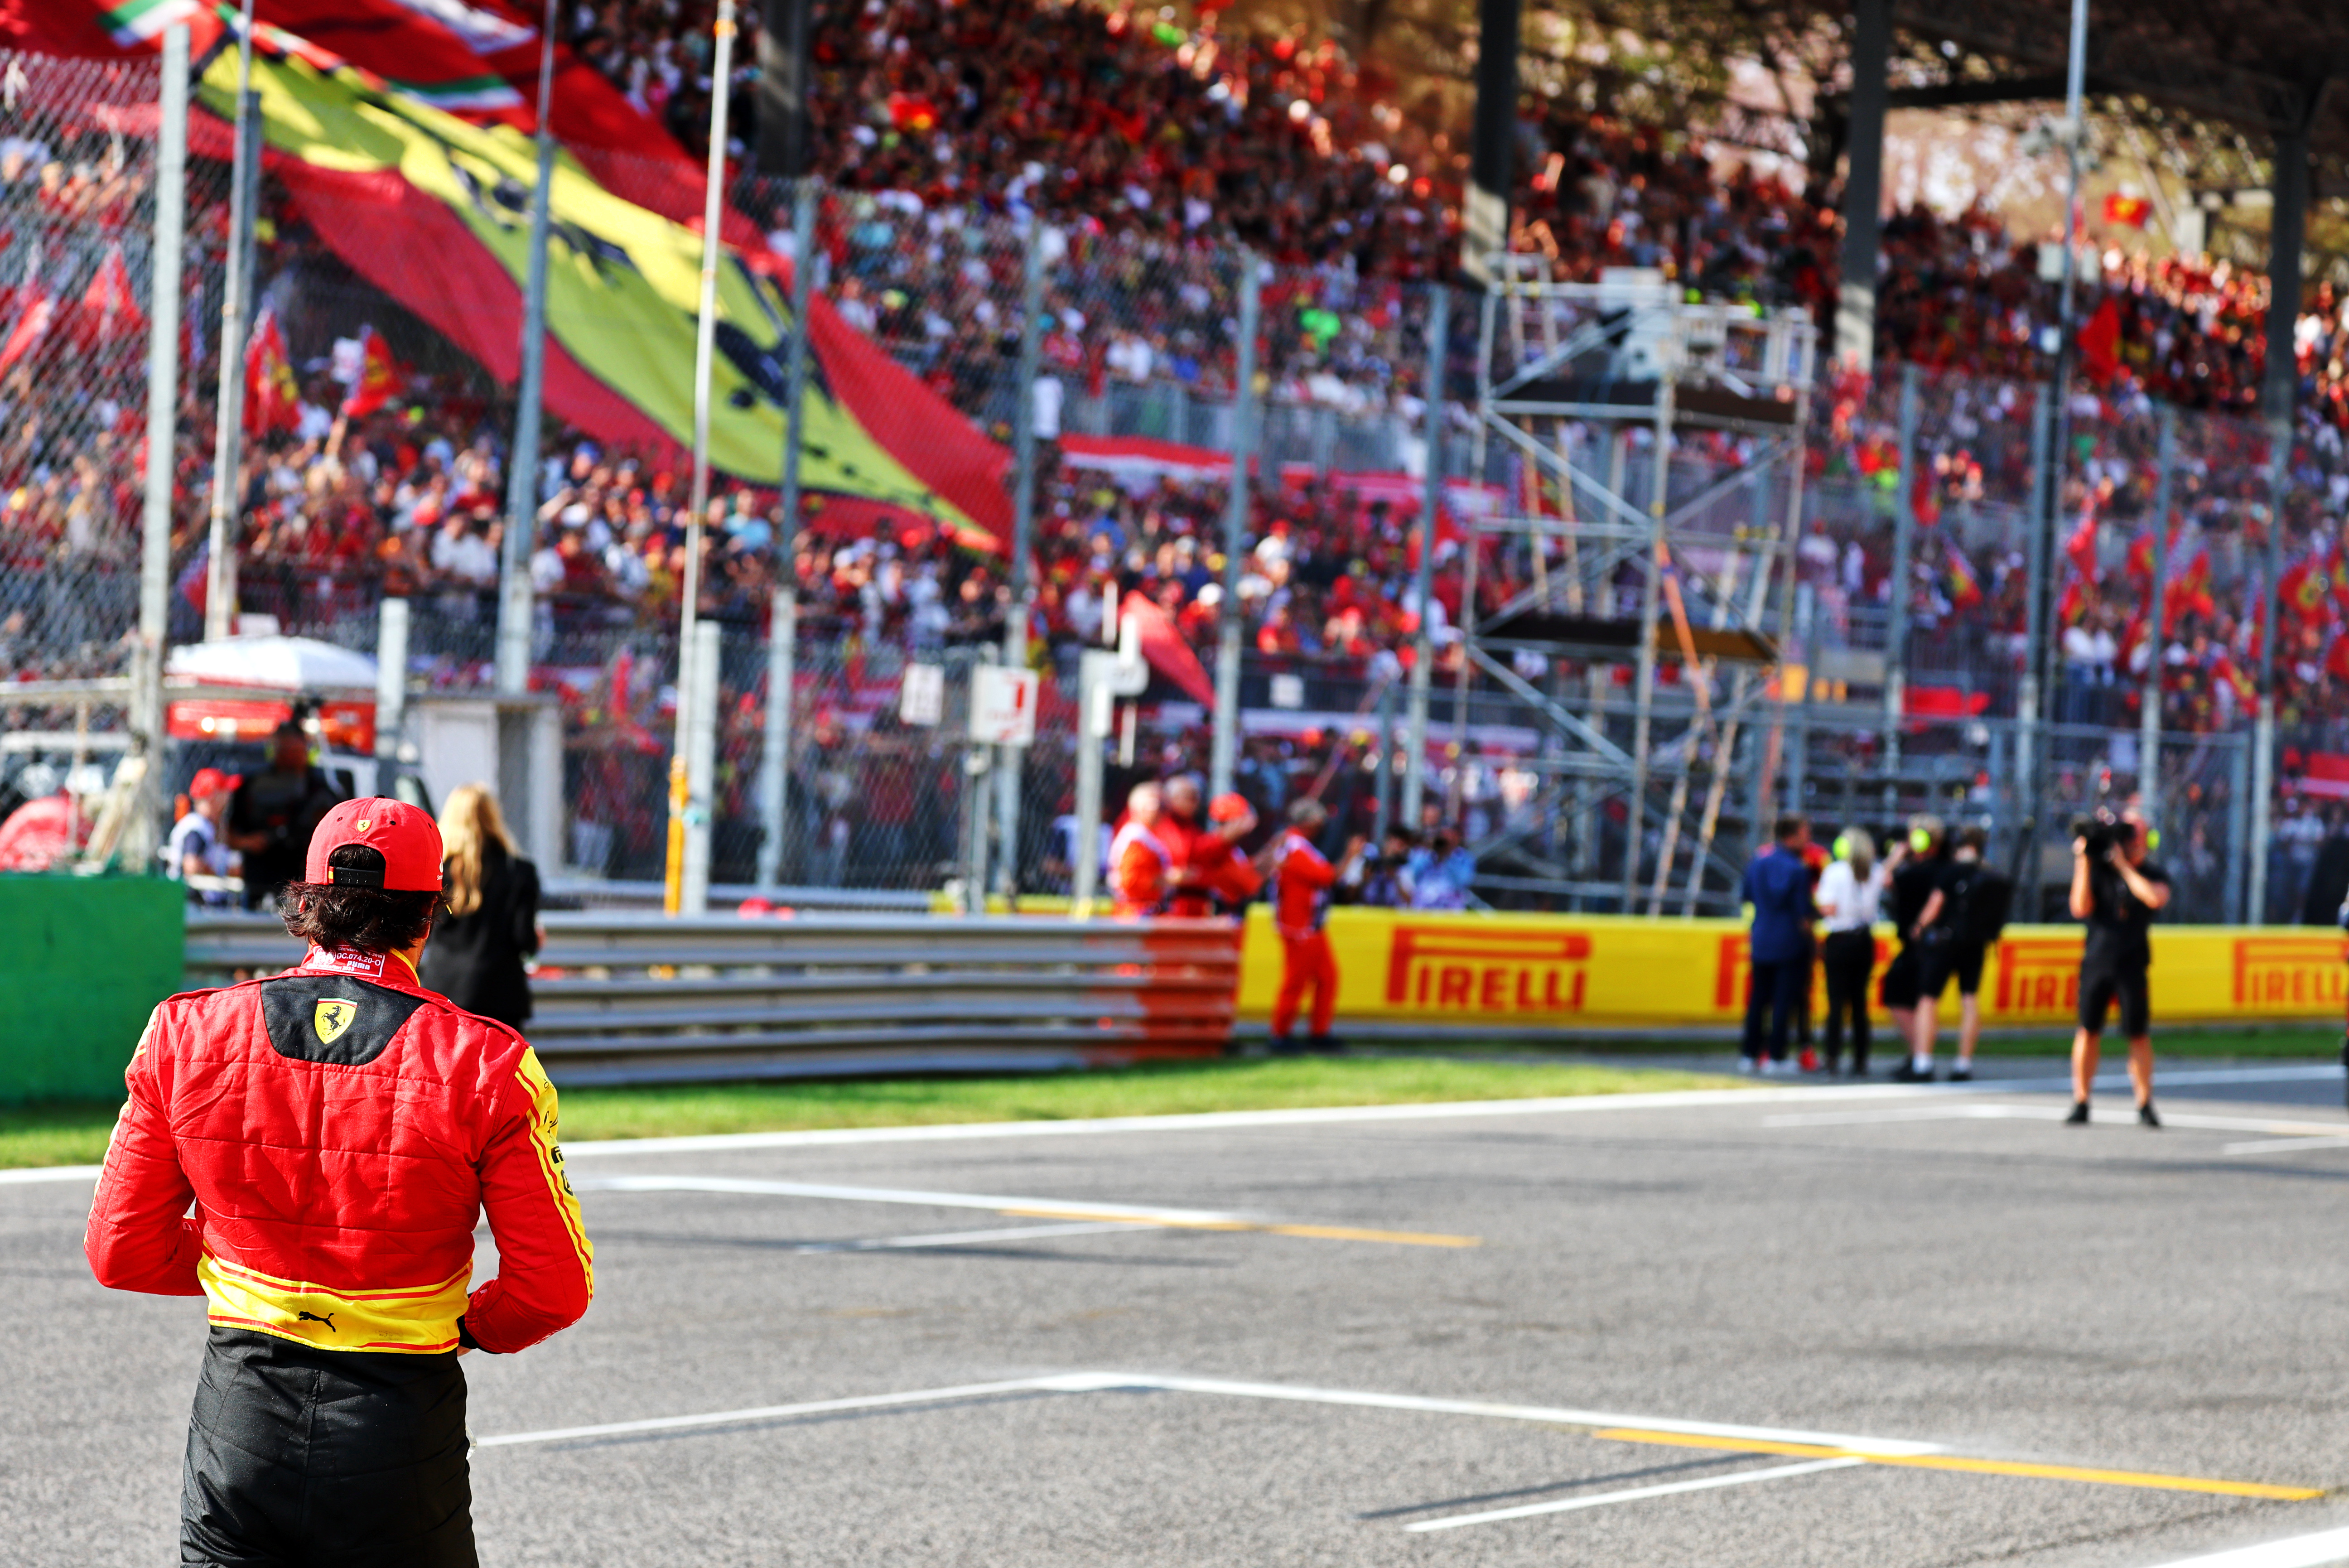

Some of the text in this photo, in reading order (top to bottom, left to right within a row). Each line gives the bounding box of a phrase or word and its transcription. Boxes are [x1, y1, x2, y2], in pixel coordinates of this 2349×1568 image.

[1385, 923, 1591, 1012] PIRELLI
[1996, 939, 2119, 1010] PIRE
[2233, 938, 2348, 1004] PIRELL
